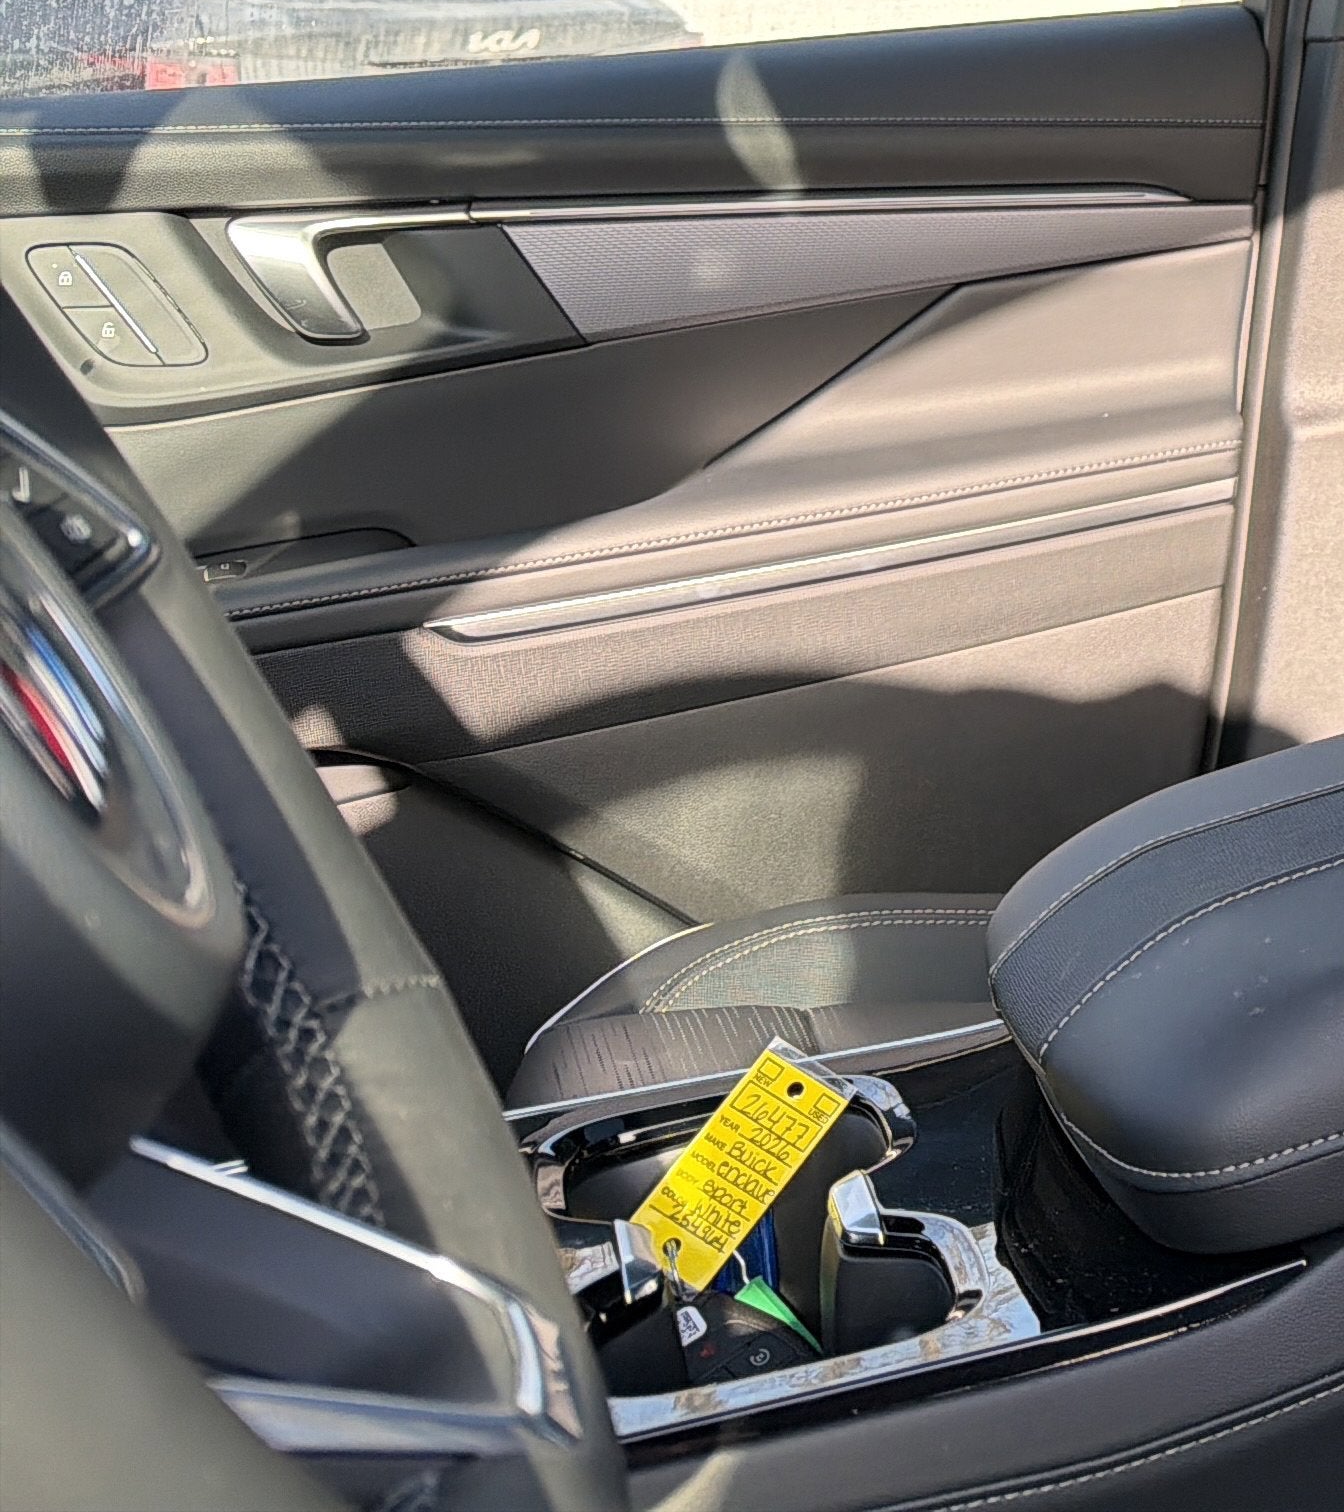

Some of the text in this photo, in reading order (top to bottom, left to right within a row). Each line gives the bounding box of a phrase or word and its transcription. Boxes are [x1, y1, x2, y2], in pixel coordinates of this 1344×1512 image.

[468, 28, 541, 53] KIA
[755, 1073, 773, 1087] NEW
[719, 1114, 790, 1161] YEAR 2026
[743, 1093, 810, 1141] 26477
[808, 1108, 828, 1124] USED
[691, 1151, 775, 1205] MODEL enclave
[704, 1133, 777, 1180] MAKE Buick
